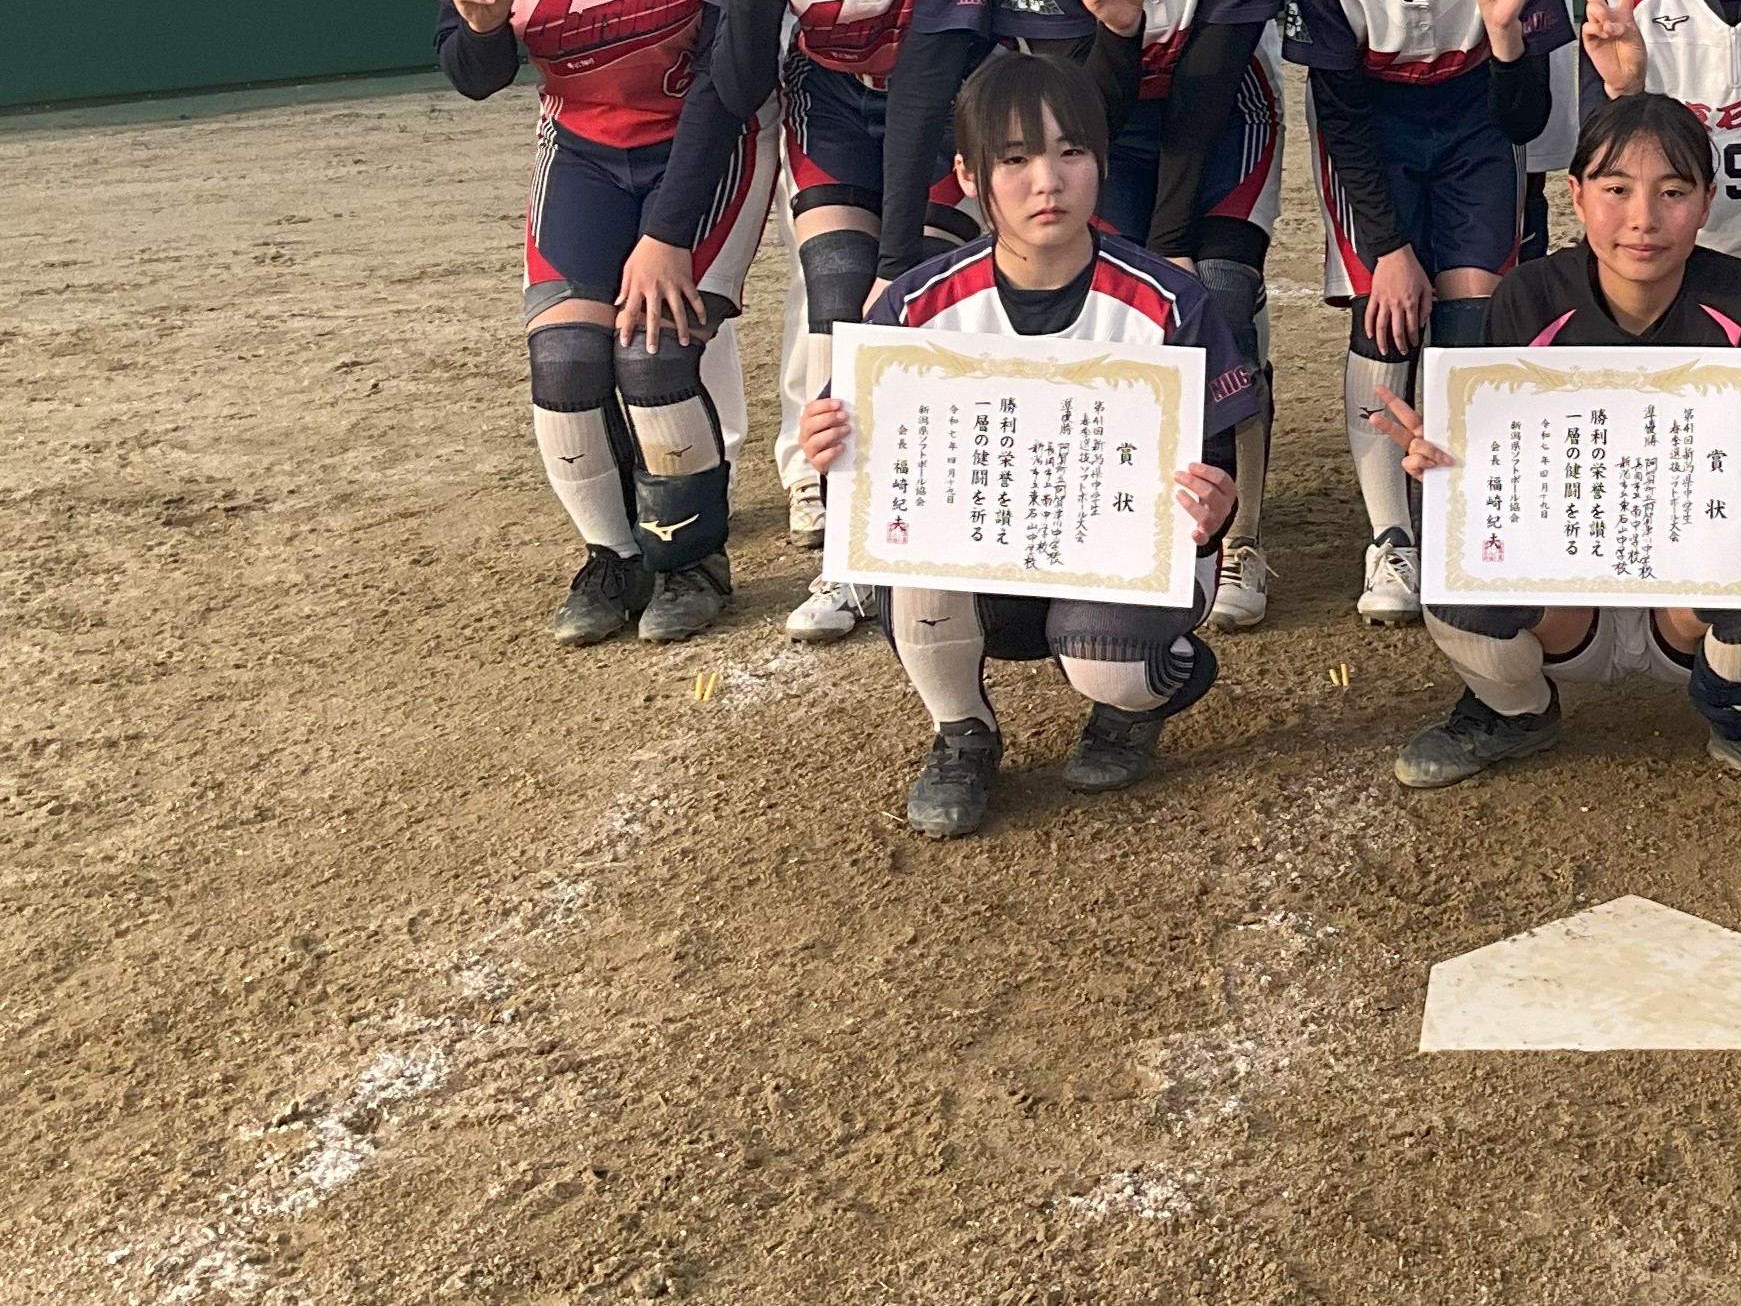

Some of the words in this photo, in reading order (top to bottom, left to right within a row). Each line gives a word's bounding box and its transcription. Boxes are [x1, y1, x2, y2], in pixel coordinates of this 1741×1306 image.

[970, 400, 991, 542] 一層の健闘を祈る
[1113, 442, 1138, 513] 賞状
[1564, 413, 1582, 555] 一層の健闘を祈る
[1705, 449, 1728, 520] 賞状
